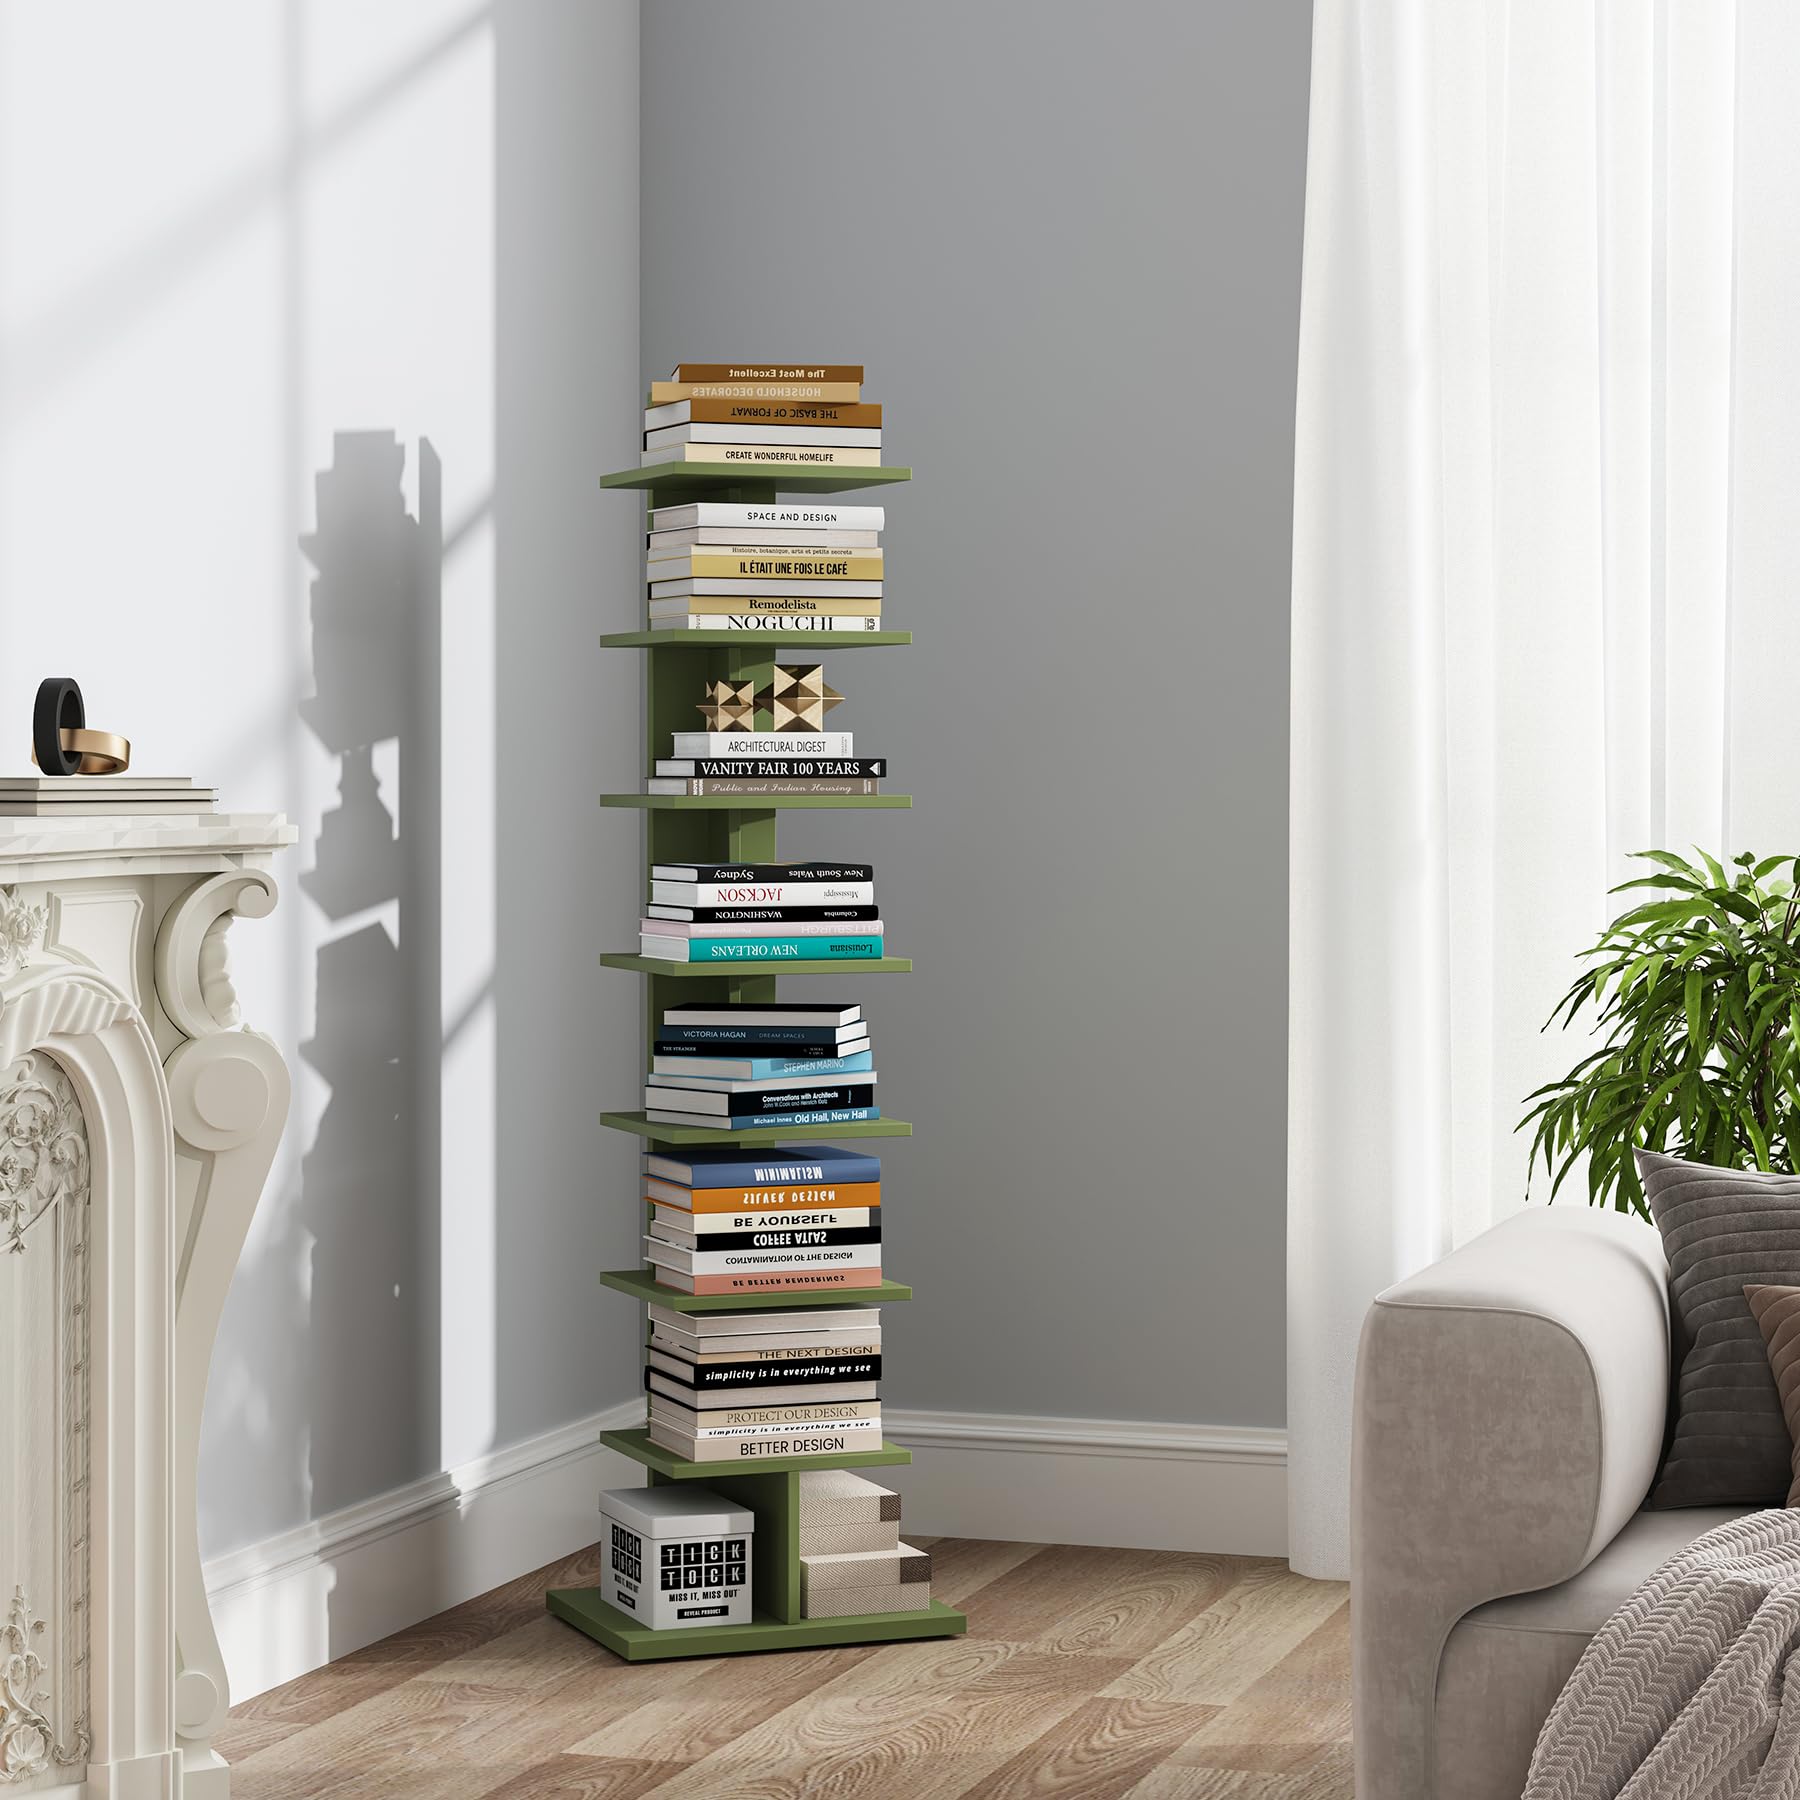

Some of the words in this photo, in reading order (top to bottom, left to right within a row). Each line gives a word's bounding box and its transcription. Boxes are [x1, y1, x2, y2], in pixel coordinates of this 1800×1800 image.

[731, 408, 770, 417] FORMAT
[774, 408, 786, 417] OF
[790, 409, 817, 418] BASIC
[820, 410, 837, 419] THE
[755, 452, 797, 460] WONDERFUL
[799, 453, 833, 461] HOMELIFE
[747, 512, 776, 520] SPACE
[780, 513, 799, 521] AND
[803, 513, 837, 521] DESIGN
[740, 561, 748, 573] IL
[750, 560, 773, 573] ÉTAIT
[775, 562, 792, 574] UNE
[794, 562, 813, 574] FOIS
[815, 563, 825, 574] LE
[827, 561, 847, 575] CAFÉ
[749, 600, 816, 610] Remodelista
[728, 616, 833, 630] NOGUCHI
[728, 741, 794, 752] ARCHITECTURAL
[797, 741, 826, 752] DIGEST
[701, 762, 755, 775] VANITY
[759, 763, 788, 775] FAIR
[793, 763, 813, 775] 100
[817, 763, 859, 774] YEARS
[712, 784, 743, 792] Public
[810, 784, 852, 794] Housing
[714, 871, 754, 879] Sydney
[789, 870, 814, 878] Wales
[717, 888, 782, 901] JACKSON
[824, 890, 858, 899] Mississippi
[712, 945, 768, 956] ORLEANS
[771, 945, 798, 955] NEW
[830, 944, 872, 955] Louisiana
[784, 1062, 815, 1072] STEPHEN
[817, 1060, 844, 1071] MARINO
[763, 1094, 799, 1103] Conversations
[813, 1092, 838, 1100] Architects
[754, 1117, 775, 1125] Michael
[795, 1113, 809, 1123] Old
[812, 1113, 829, 1123] Hall,
[831, 1111, 849, 1121] New
[851, 1110, 867, 1120] Hall
[758, 1351, 781, 1359] THE
[787, 1349, 819, 1357] NEXT
[825, 1347, 872, 1355] DESIGN
[705, 1370, 755, 1381] simplicity
[759, 1369, 767, 1377] is
[770, 1368, 780, 1376] in
[783, 1365, 835, 1376] everything
[855, 1364, 871, 1372] see
[727, 1410, 782, 1423] PROTECT
[784, 1410, 812, 1420] OUR
[814, 1407, 858, 1418] DESIGN
[785, 1423, 836, 1432] everything
[741, 1441, 788, 1455] BETTER
[793, 1438, 844, 1452] DESIGN
[666, 1543, 741, 1563] TICK
[666, 1566, 741, 1586] TOCK
[669, 1593, 688, 1602] MISS
[690, 1593, 699, 1601] IT,
[703, 1591, 721, 1599] MISS
